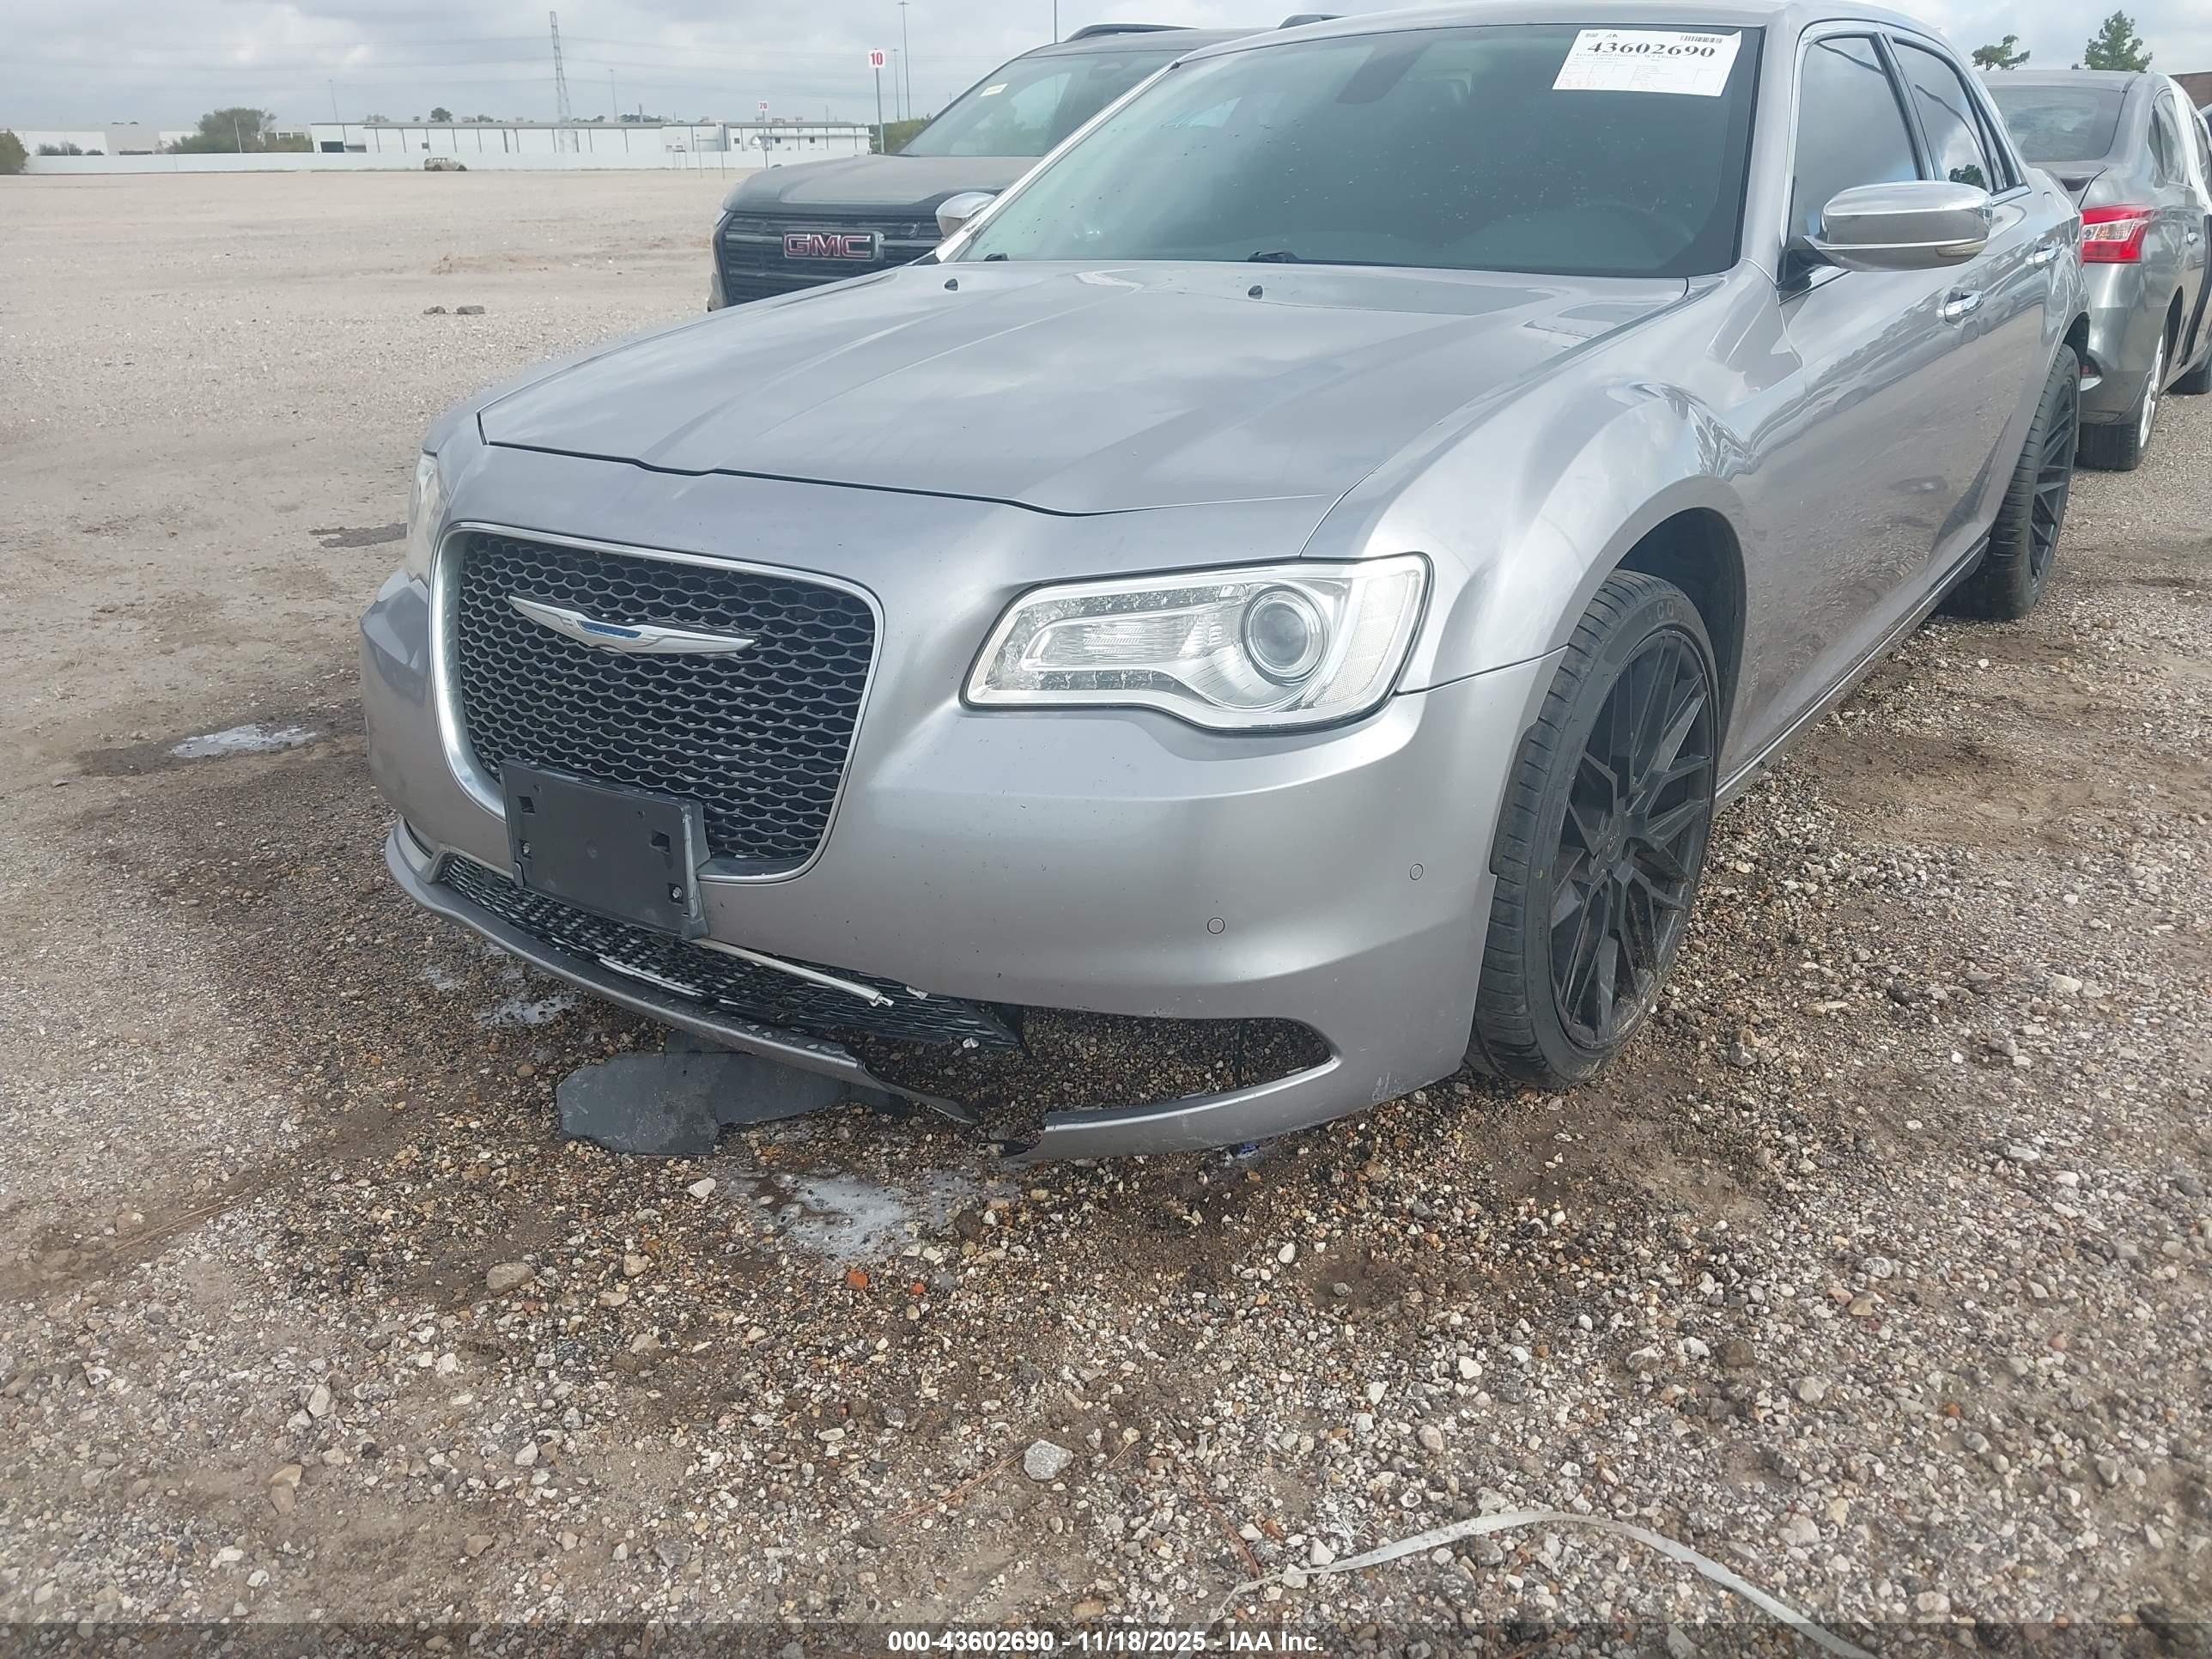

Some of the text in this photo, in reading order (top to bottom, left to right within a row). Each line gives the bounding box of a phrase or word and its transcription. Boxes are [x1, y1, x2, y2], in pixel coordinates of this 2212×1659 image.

[1587, 41, 1716, 58] 43602690
[870, 52, 884, 66] 10
[784, 233, 872, 258] GMC
